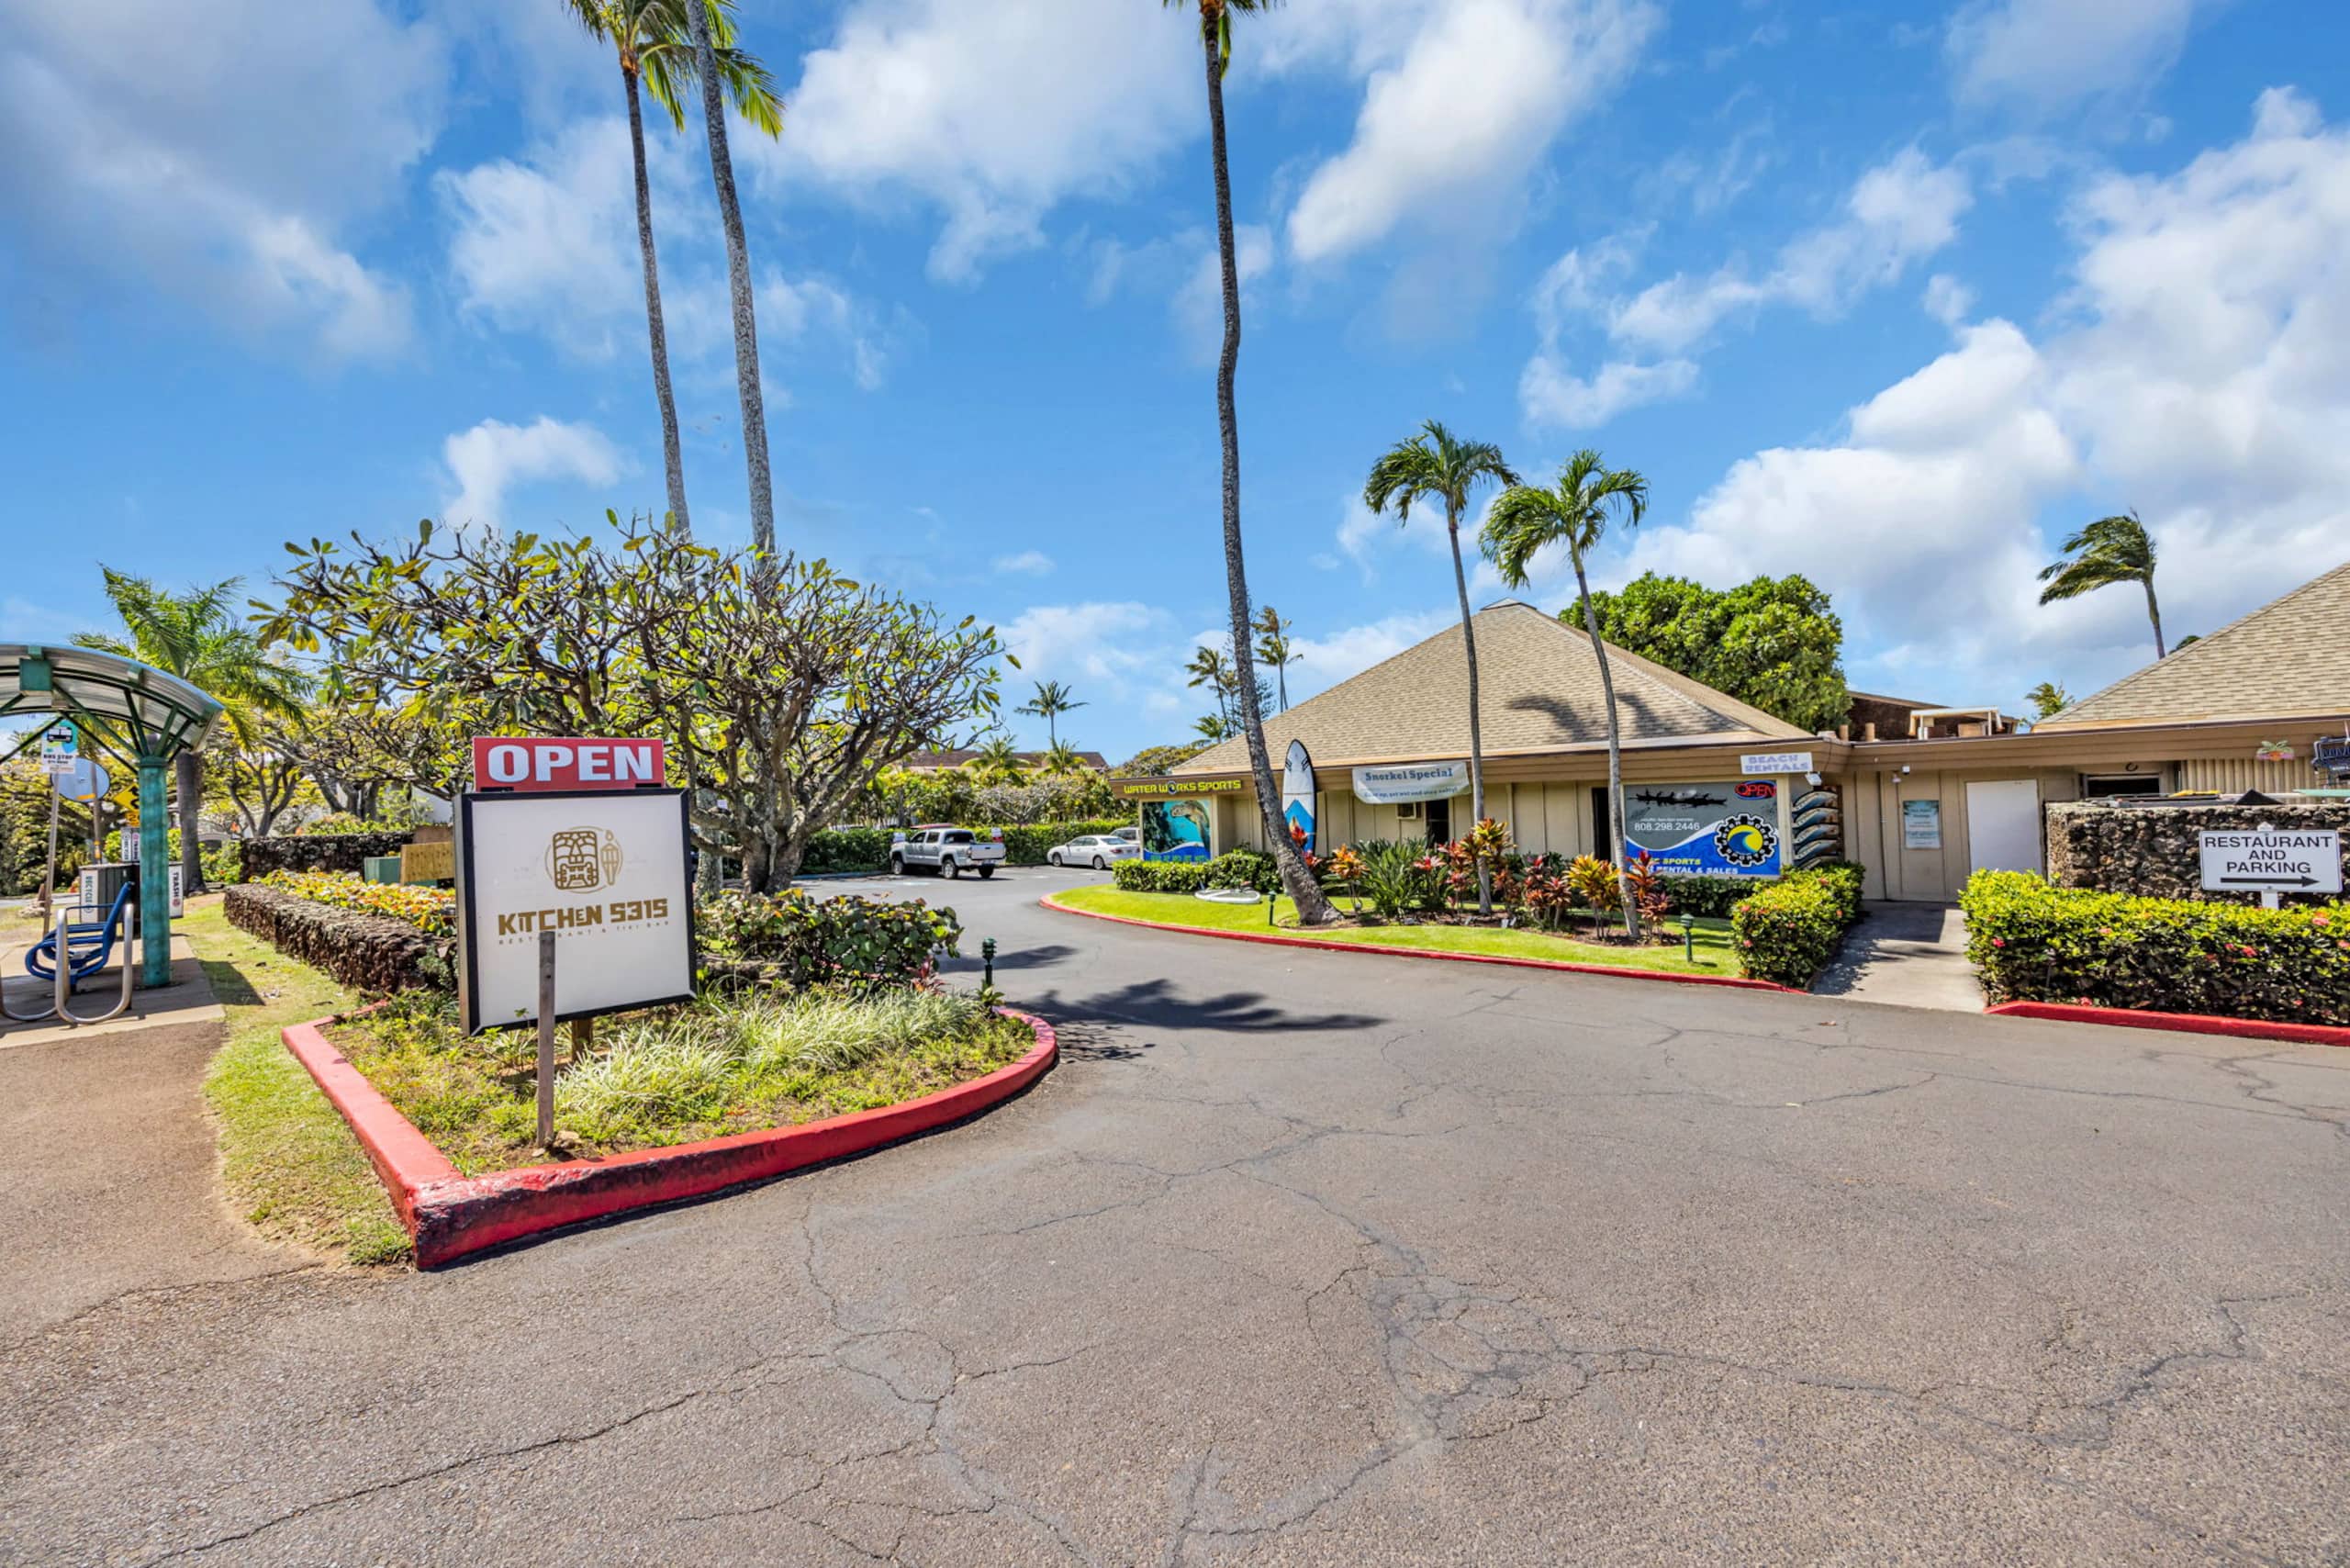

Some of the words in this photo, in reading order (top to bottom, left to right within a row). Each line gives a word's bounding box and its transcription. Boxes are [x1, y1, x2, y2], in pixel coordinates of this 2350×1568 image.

[487, 745, 653, 782] OPEN
[1749, 755, 1798, 764] BEACH
[1365, 771, 1407, 780] Snorkel
[1409, 767, 1453, 779] Special
[1745, 762, 1808, 772] RENTALS
[1124, 784, 1157, 794] WATER
[1198, 780, 1242, 791] SPORTS
[1734, 783, 1777, 797] OPEN
[2205, 836, 2333, 847] RESTAURANT
[2249, 849, 2286, 860] AND
[1707, 867, 1739, 875] SALES
[2227, 861, 2311, 873] PARKING
[173, 872, 181, 898] TRASH
[610, 898, 668, 924] 5315
[498, 928, 592, 946] RESTRANT
